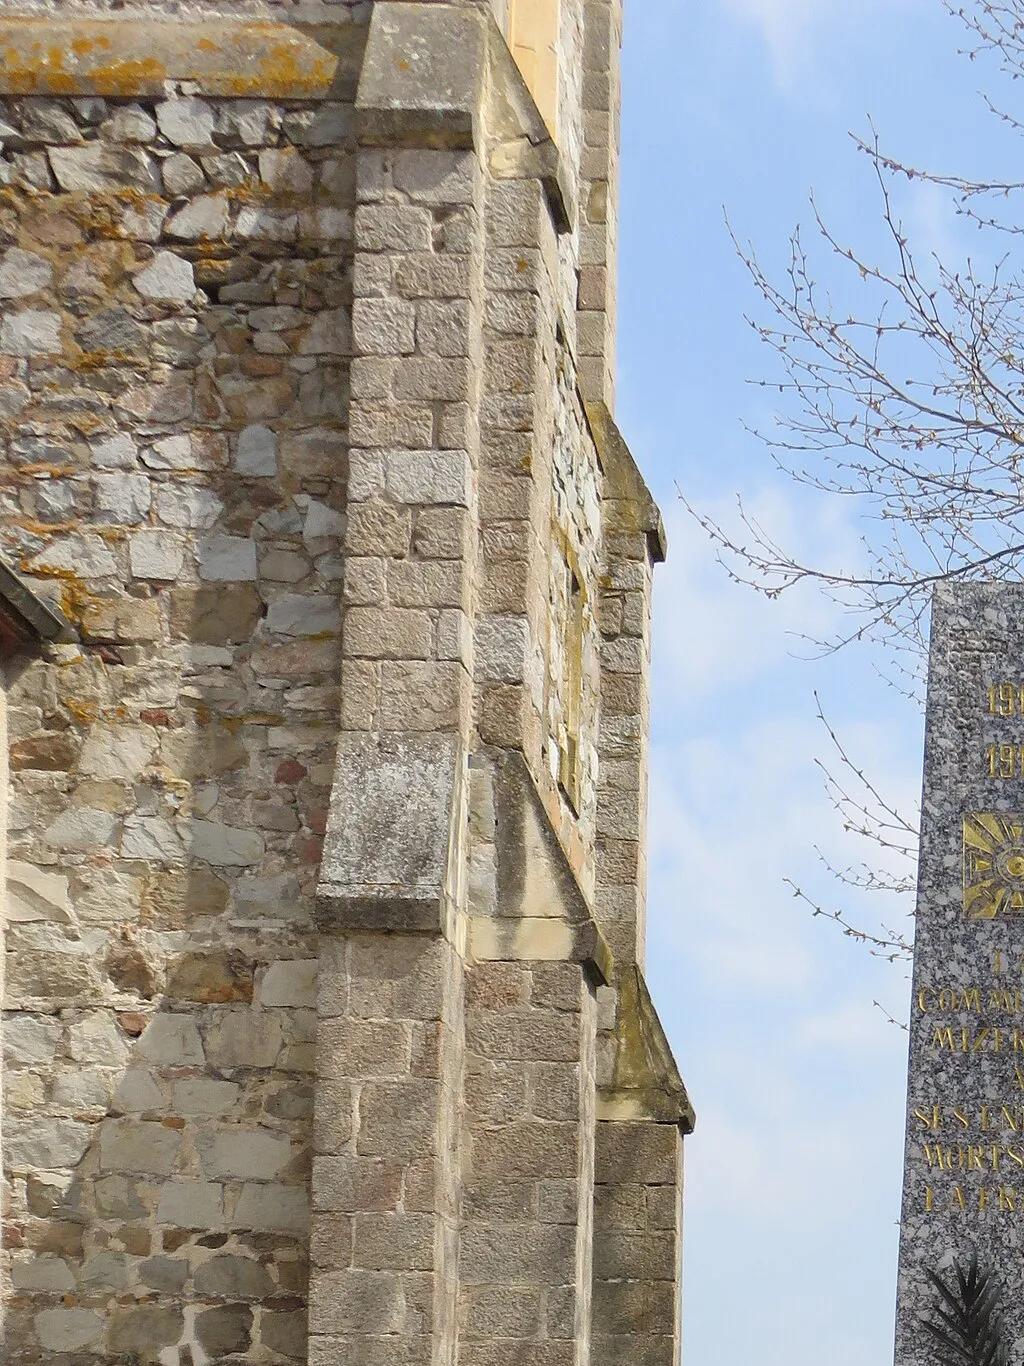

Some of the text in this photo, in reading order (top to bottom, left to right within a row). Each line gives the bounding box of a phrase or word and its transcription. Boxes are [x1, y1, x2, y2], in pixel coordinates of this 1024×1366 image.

[914, 1104, 969, 1132] SES
[923, 1145, 1024, 1170] MORTS
[925, 1186, 966, 1211] LA
